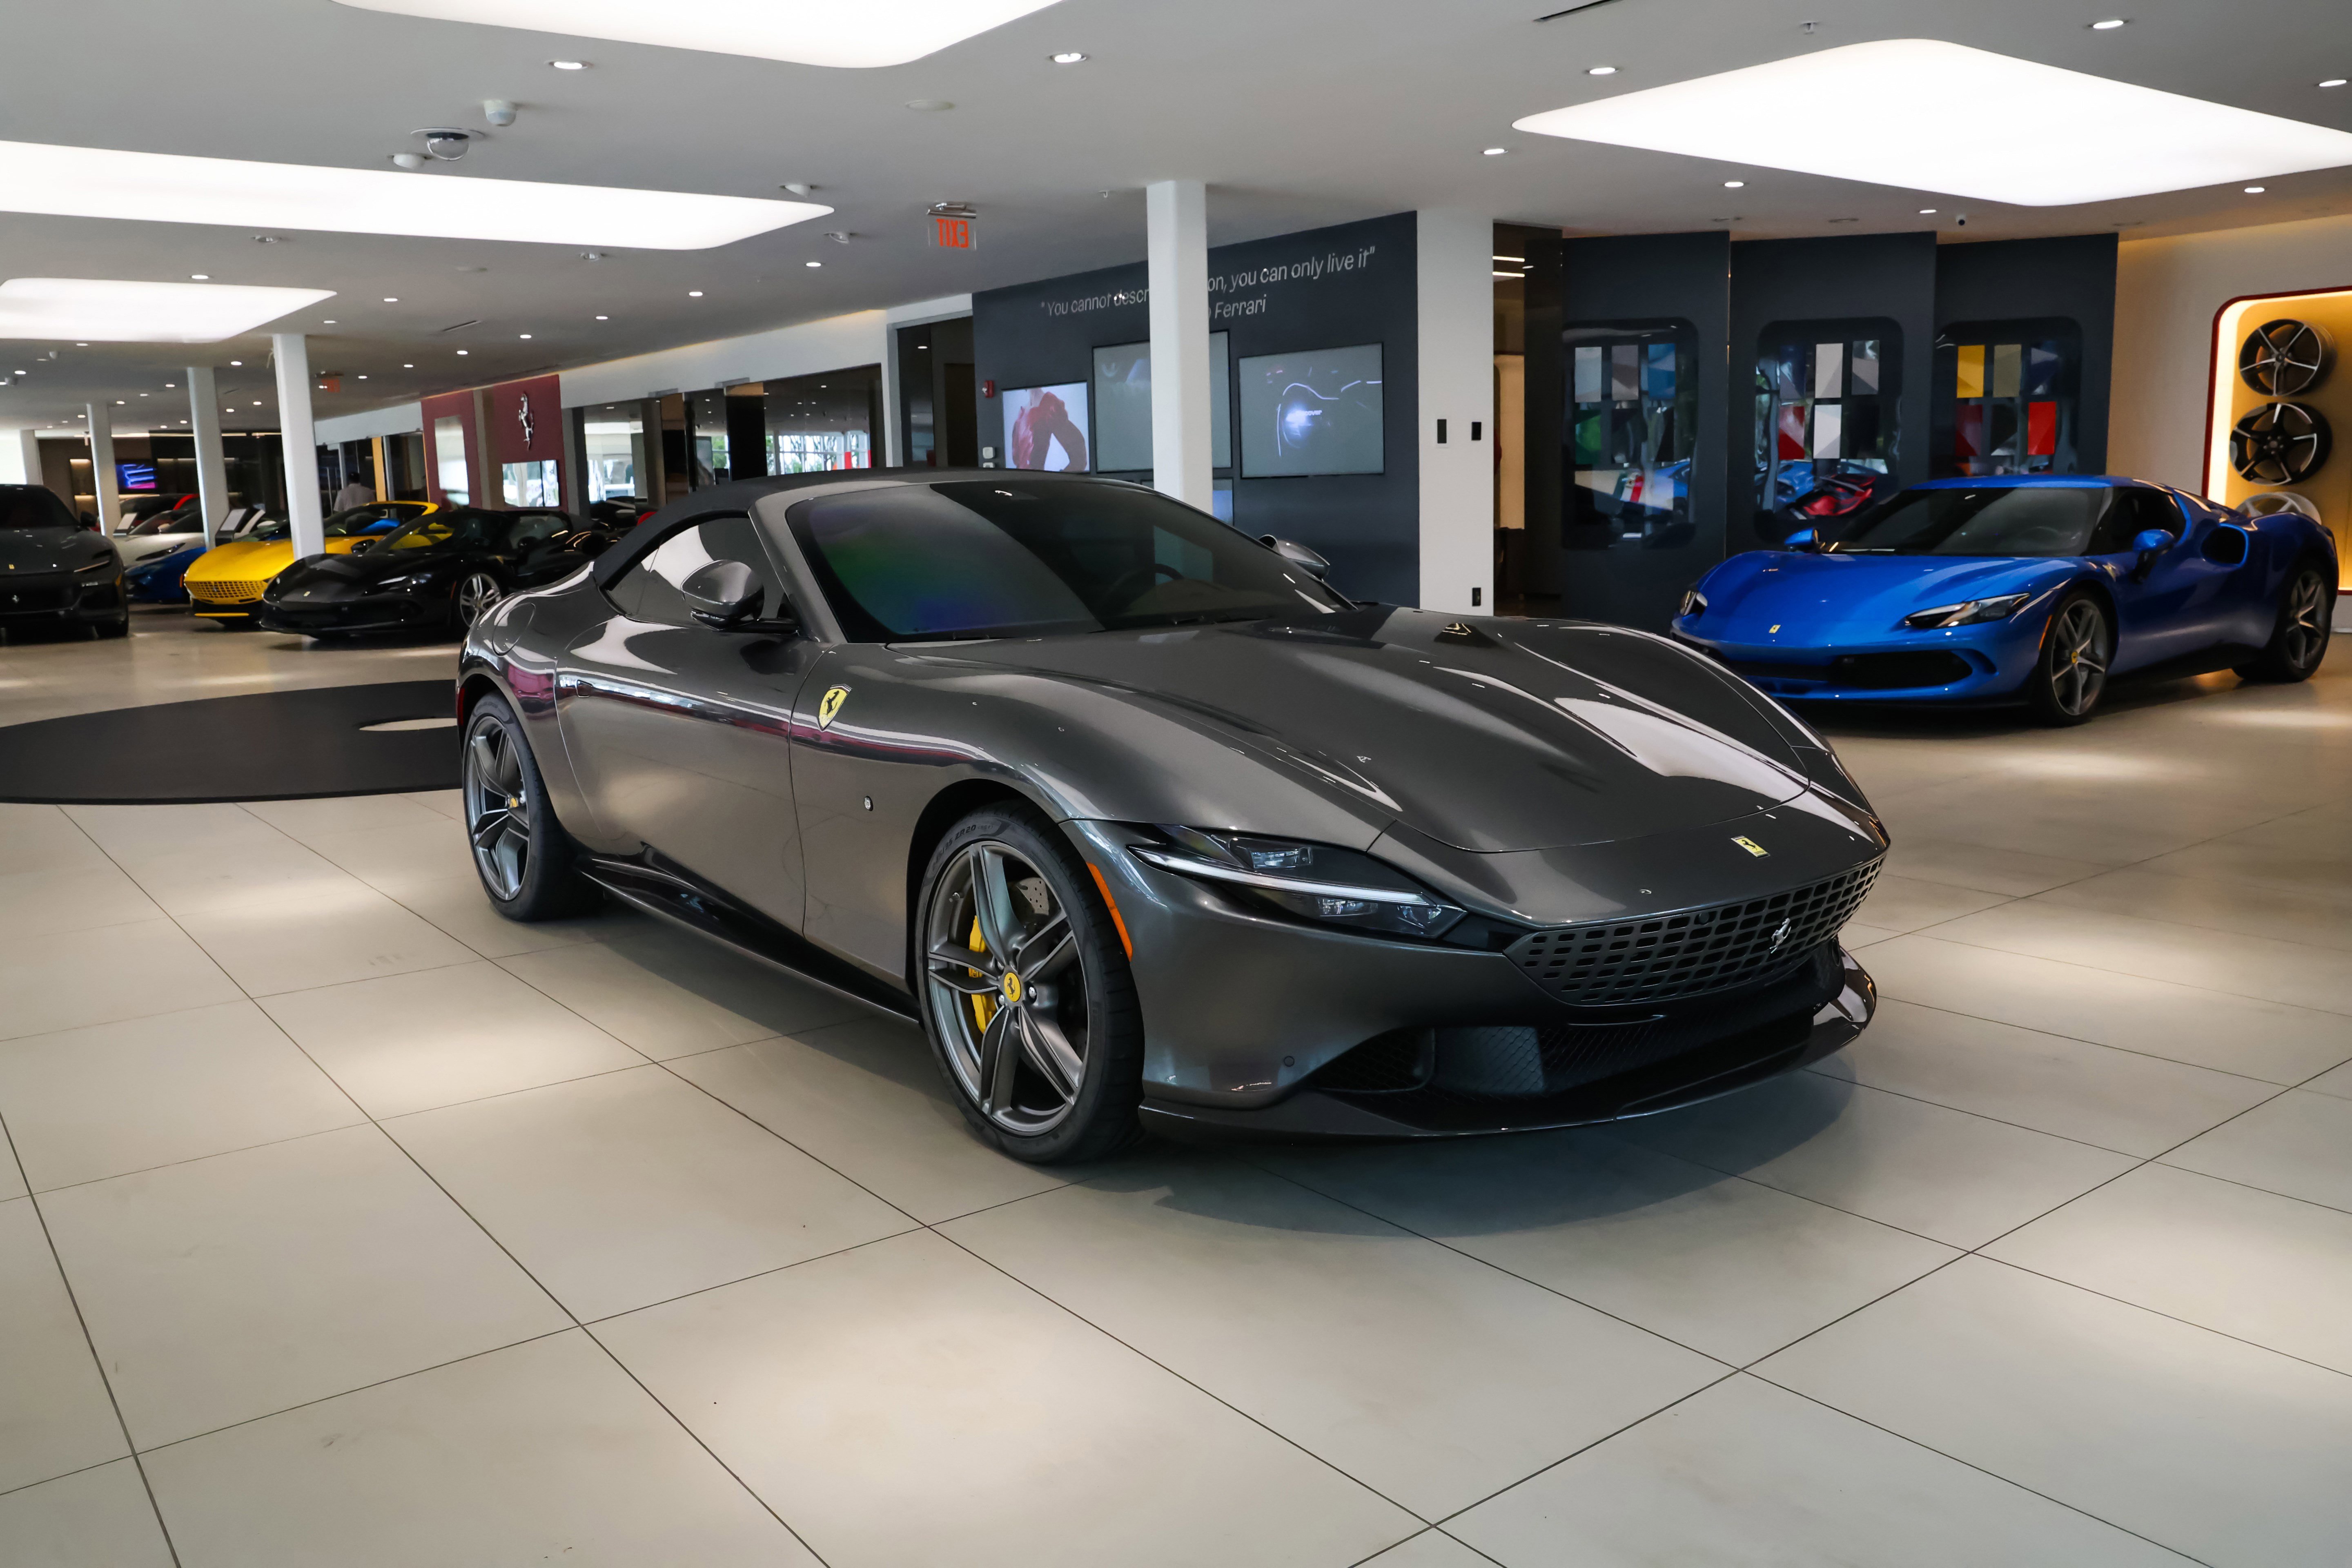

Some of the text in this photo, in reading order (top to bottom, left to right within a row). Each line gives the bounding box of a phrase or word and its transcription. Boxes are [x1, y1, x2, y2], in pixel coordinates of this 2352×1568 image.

[1071, 293, 1111, 313] cannot
[1114, 288, 1149, 307] descr
[1229, 271, 1257, 292] you
[1260, 266, 1287, 283] can
[1291, 256, 1324, 279] only
[1327, 253, 1354, 273] live
[1215, 294, 1267, 319] Ferrari
